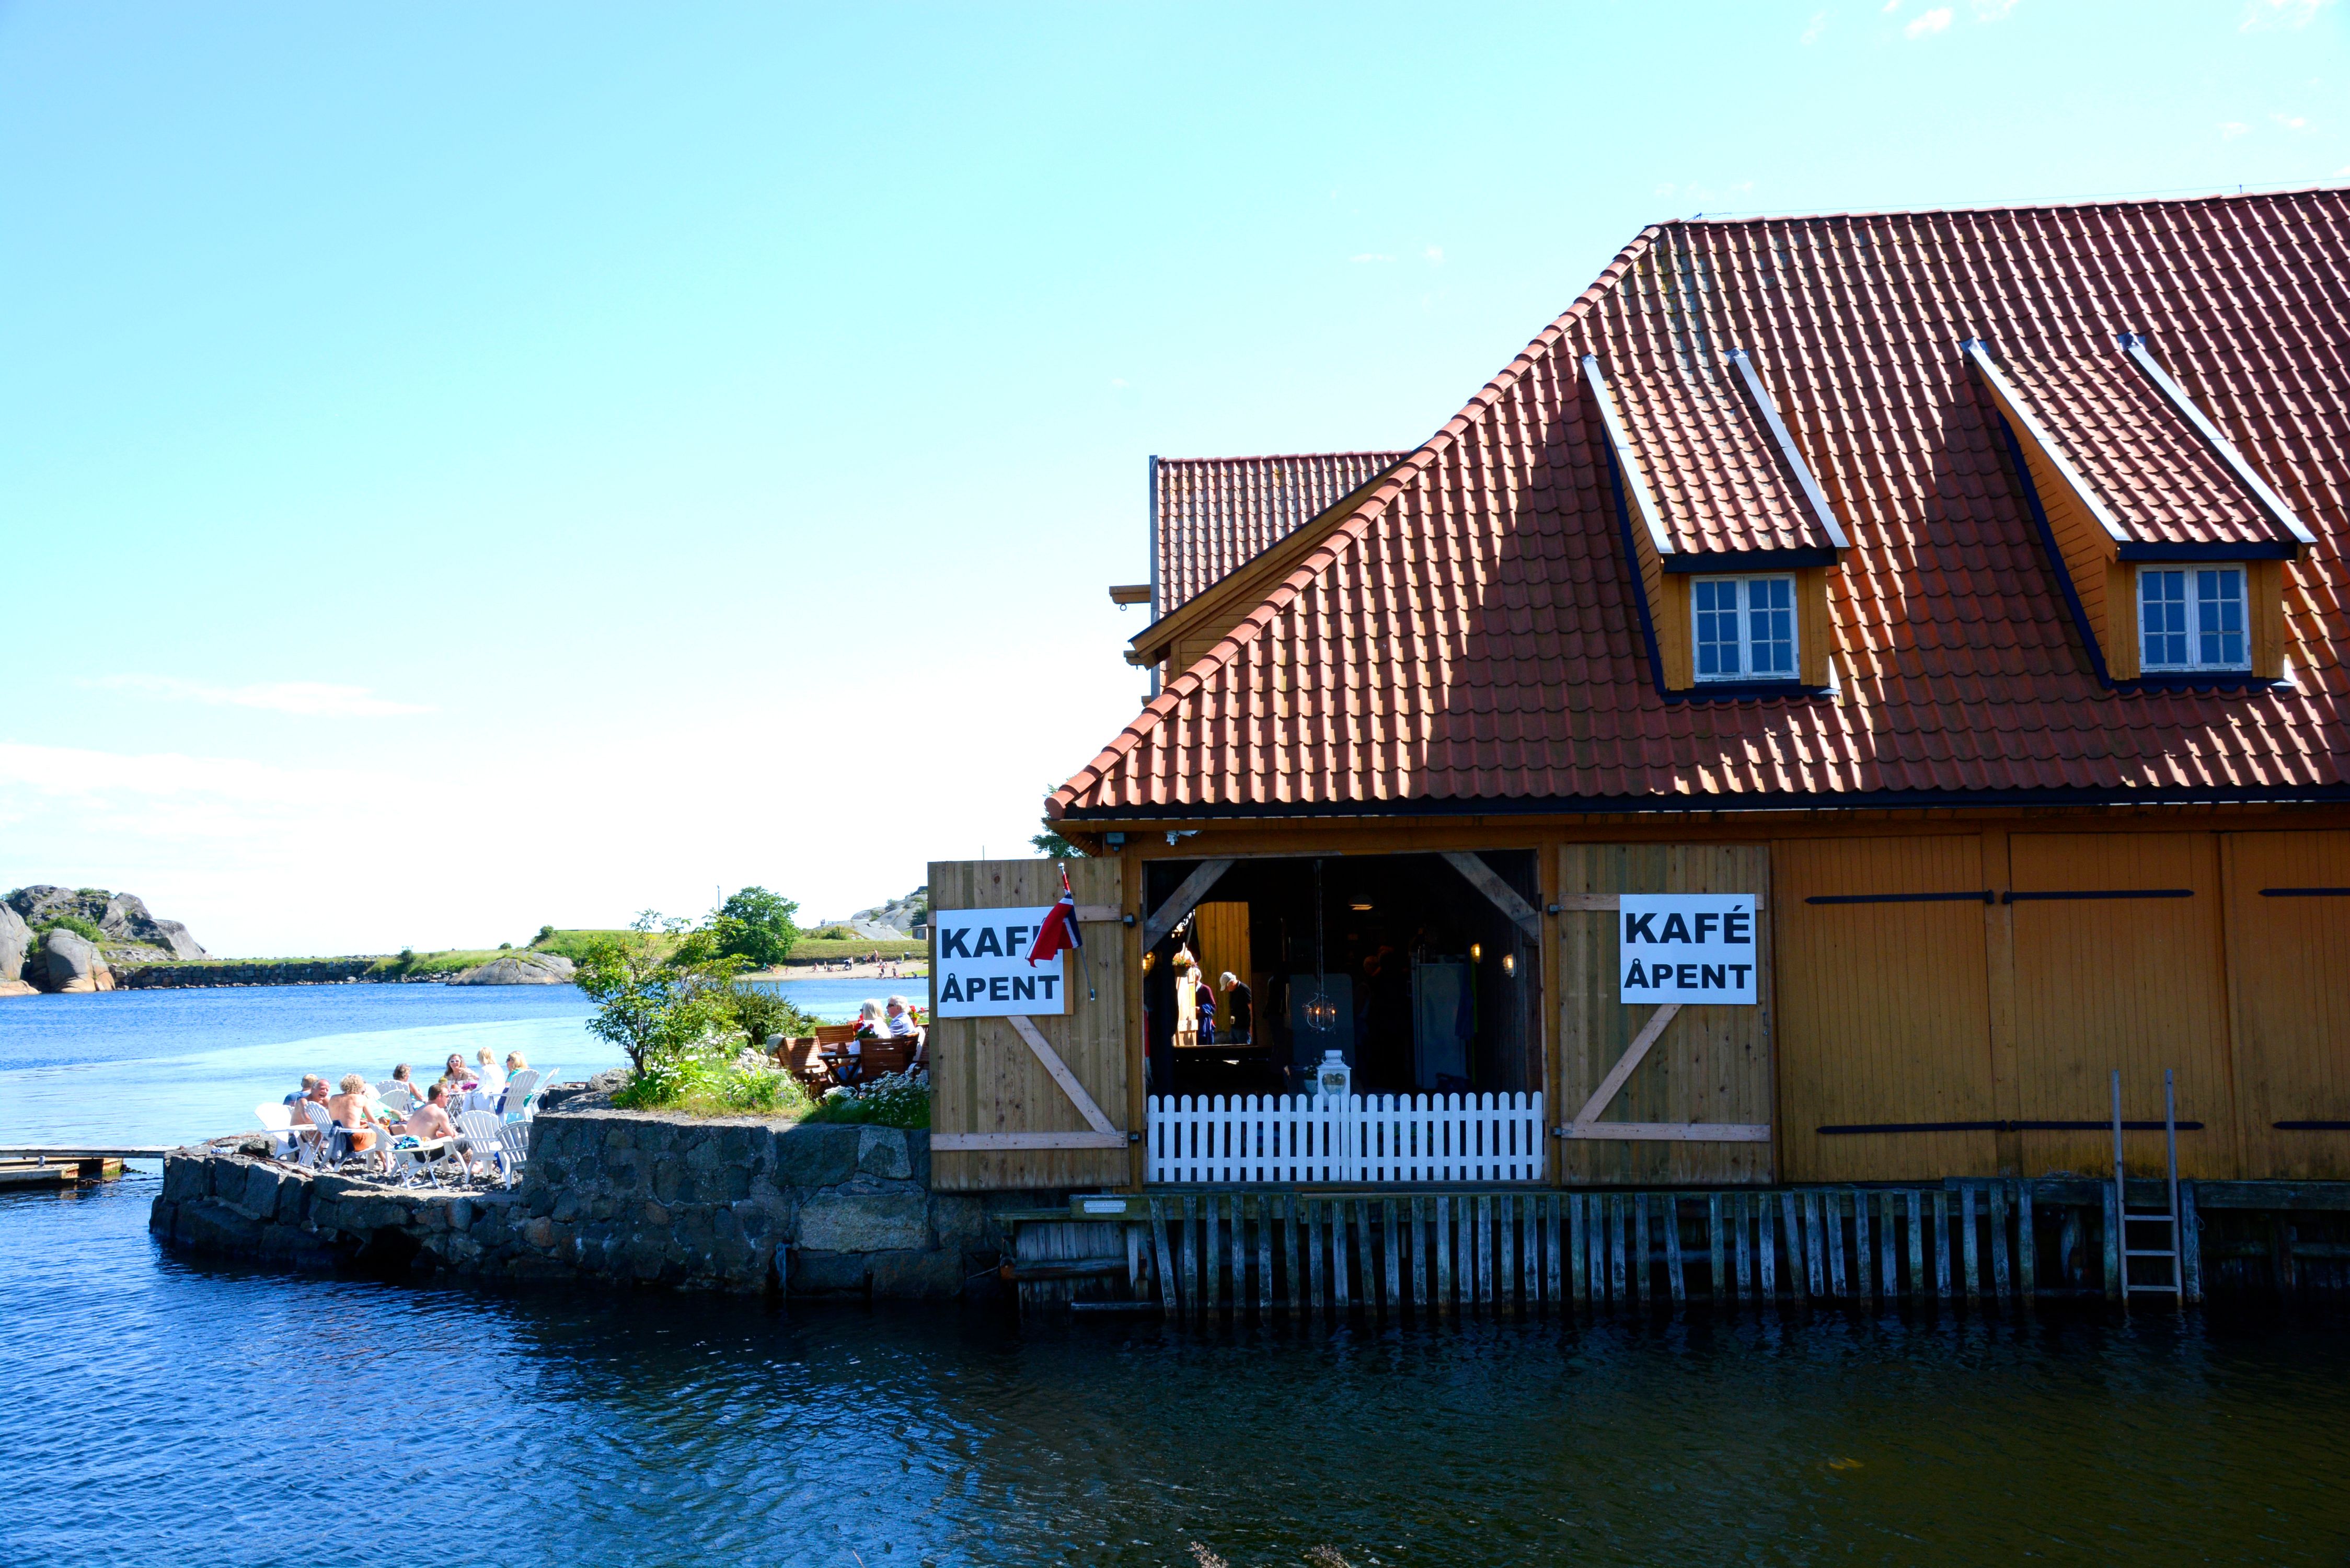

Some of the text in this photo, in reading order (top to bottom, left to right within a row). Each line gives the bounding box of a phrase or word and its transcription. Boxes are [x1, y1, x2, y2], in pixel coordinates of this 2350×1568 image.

[941, 923, 1057, 959] KAF
[1626, 905, 1750, 944] KAFÉ
[940, 973, 1059, 1003] ÅPENT
[1624, 958, 1752, 989] ÅPENT
